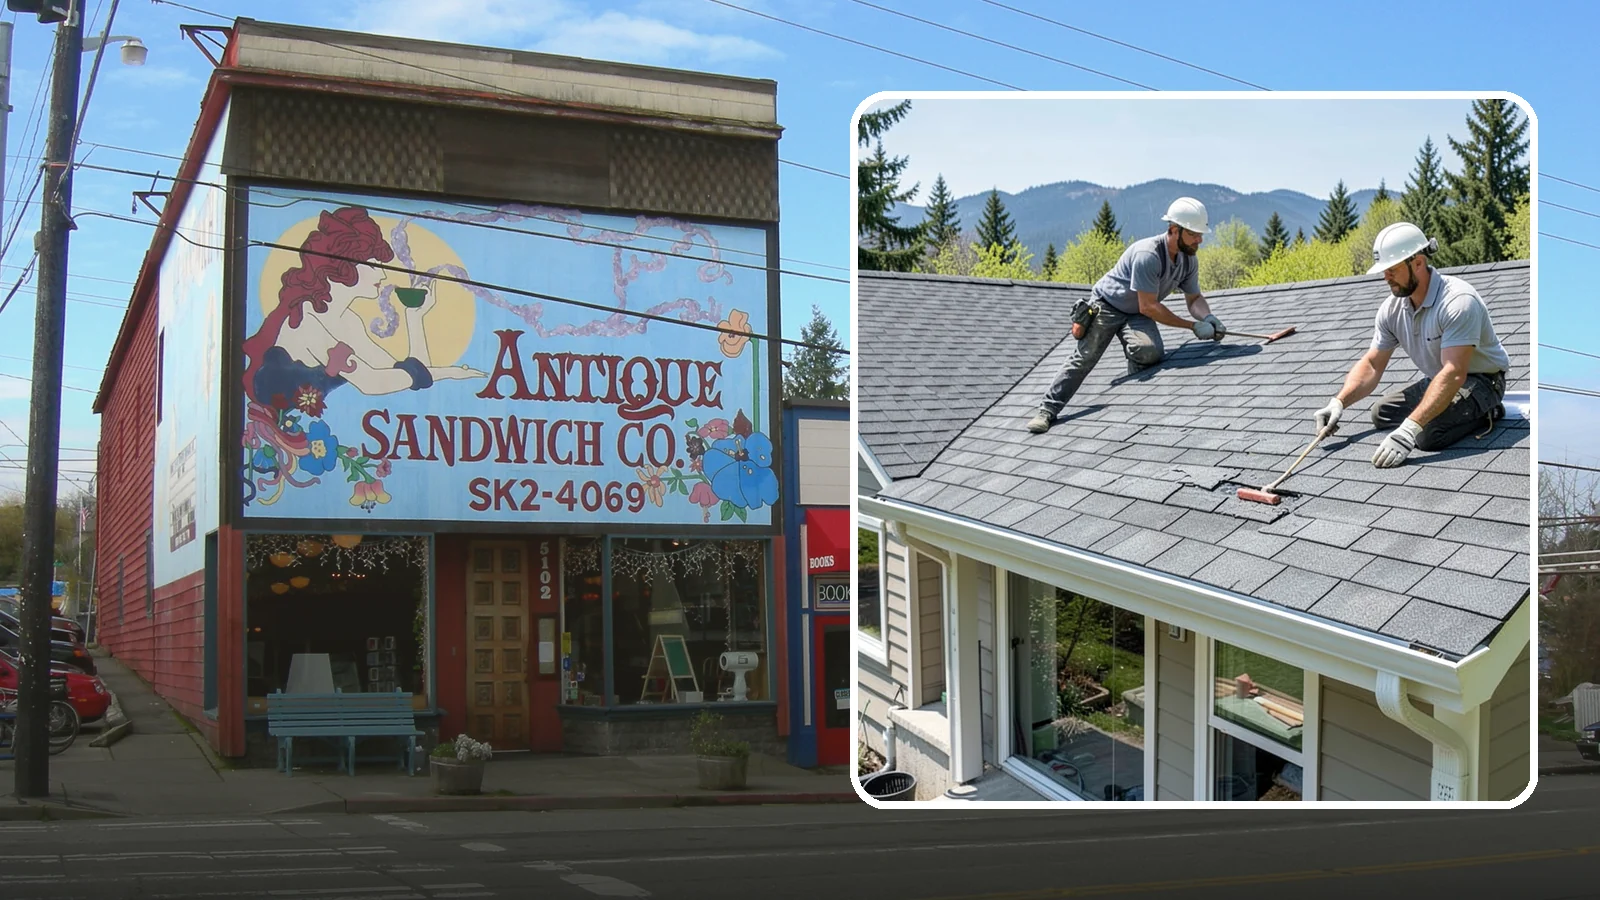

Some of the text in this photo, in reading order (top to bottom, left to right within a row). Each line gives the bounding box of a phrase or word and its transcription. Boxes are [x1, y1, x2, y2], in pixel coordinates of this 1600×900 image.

[476, 330, 723, 420] ANTIQUE
[362, 409, 684, 468] SANDWICH CO.
[469, 477, 646, 513] SK2-4069
[540, 541, 551, 599] 5102
[809, 555, 835, 568] BOOKS
